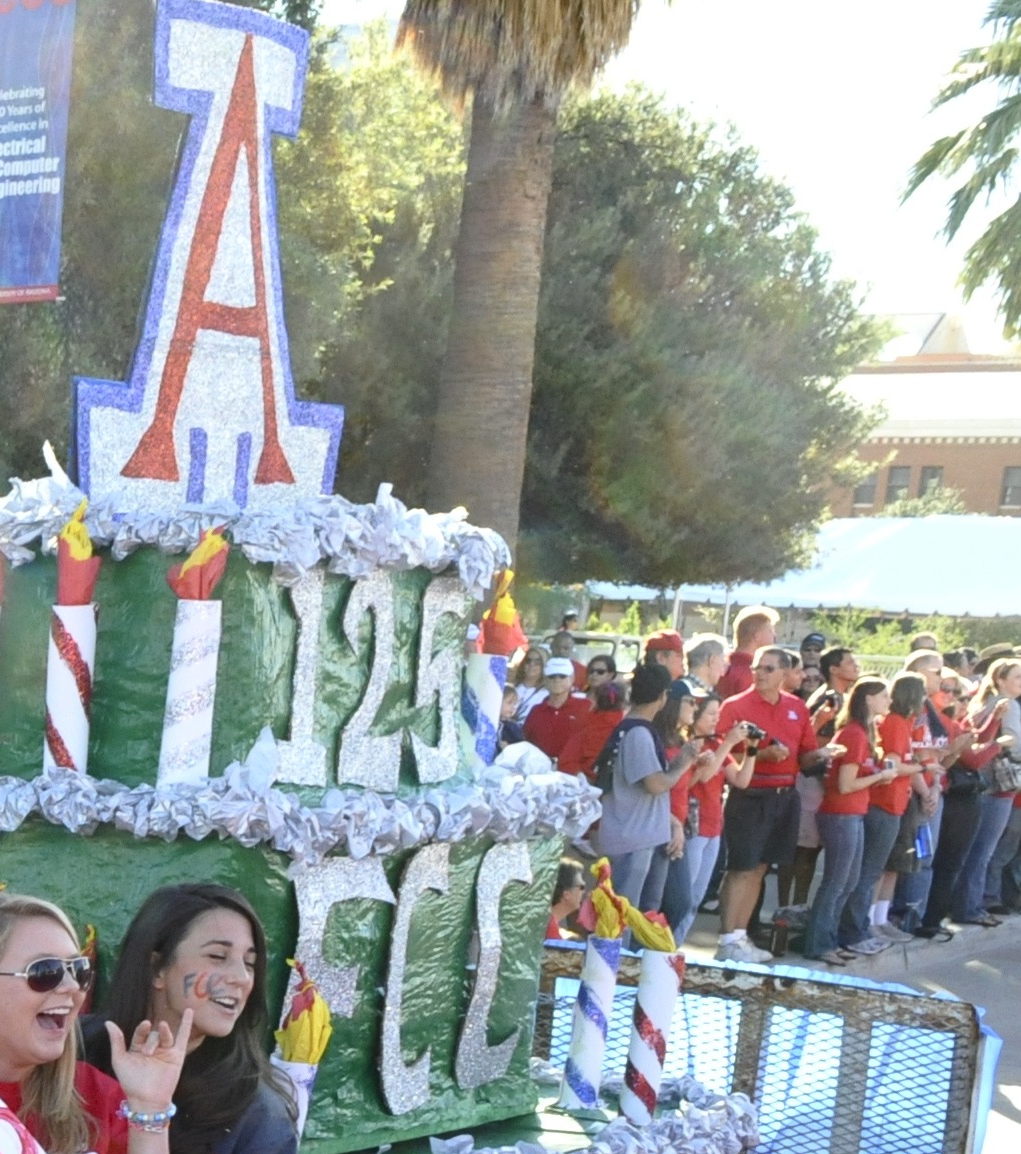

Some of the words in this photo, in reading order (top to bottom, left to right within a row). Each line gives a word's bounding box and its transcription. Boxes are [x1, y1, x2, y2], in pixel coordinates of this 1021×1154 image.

[7, 104, 33, 116] Years
[34, 100, 46, 113] of
[38, 117, 49, 130] in
[71, 0, 345, 506] A
[275, 562, 465, 788] 125
